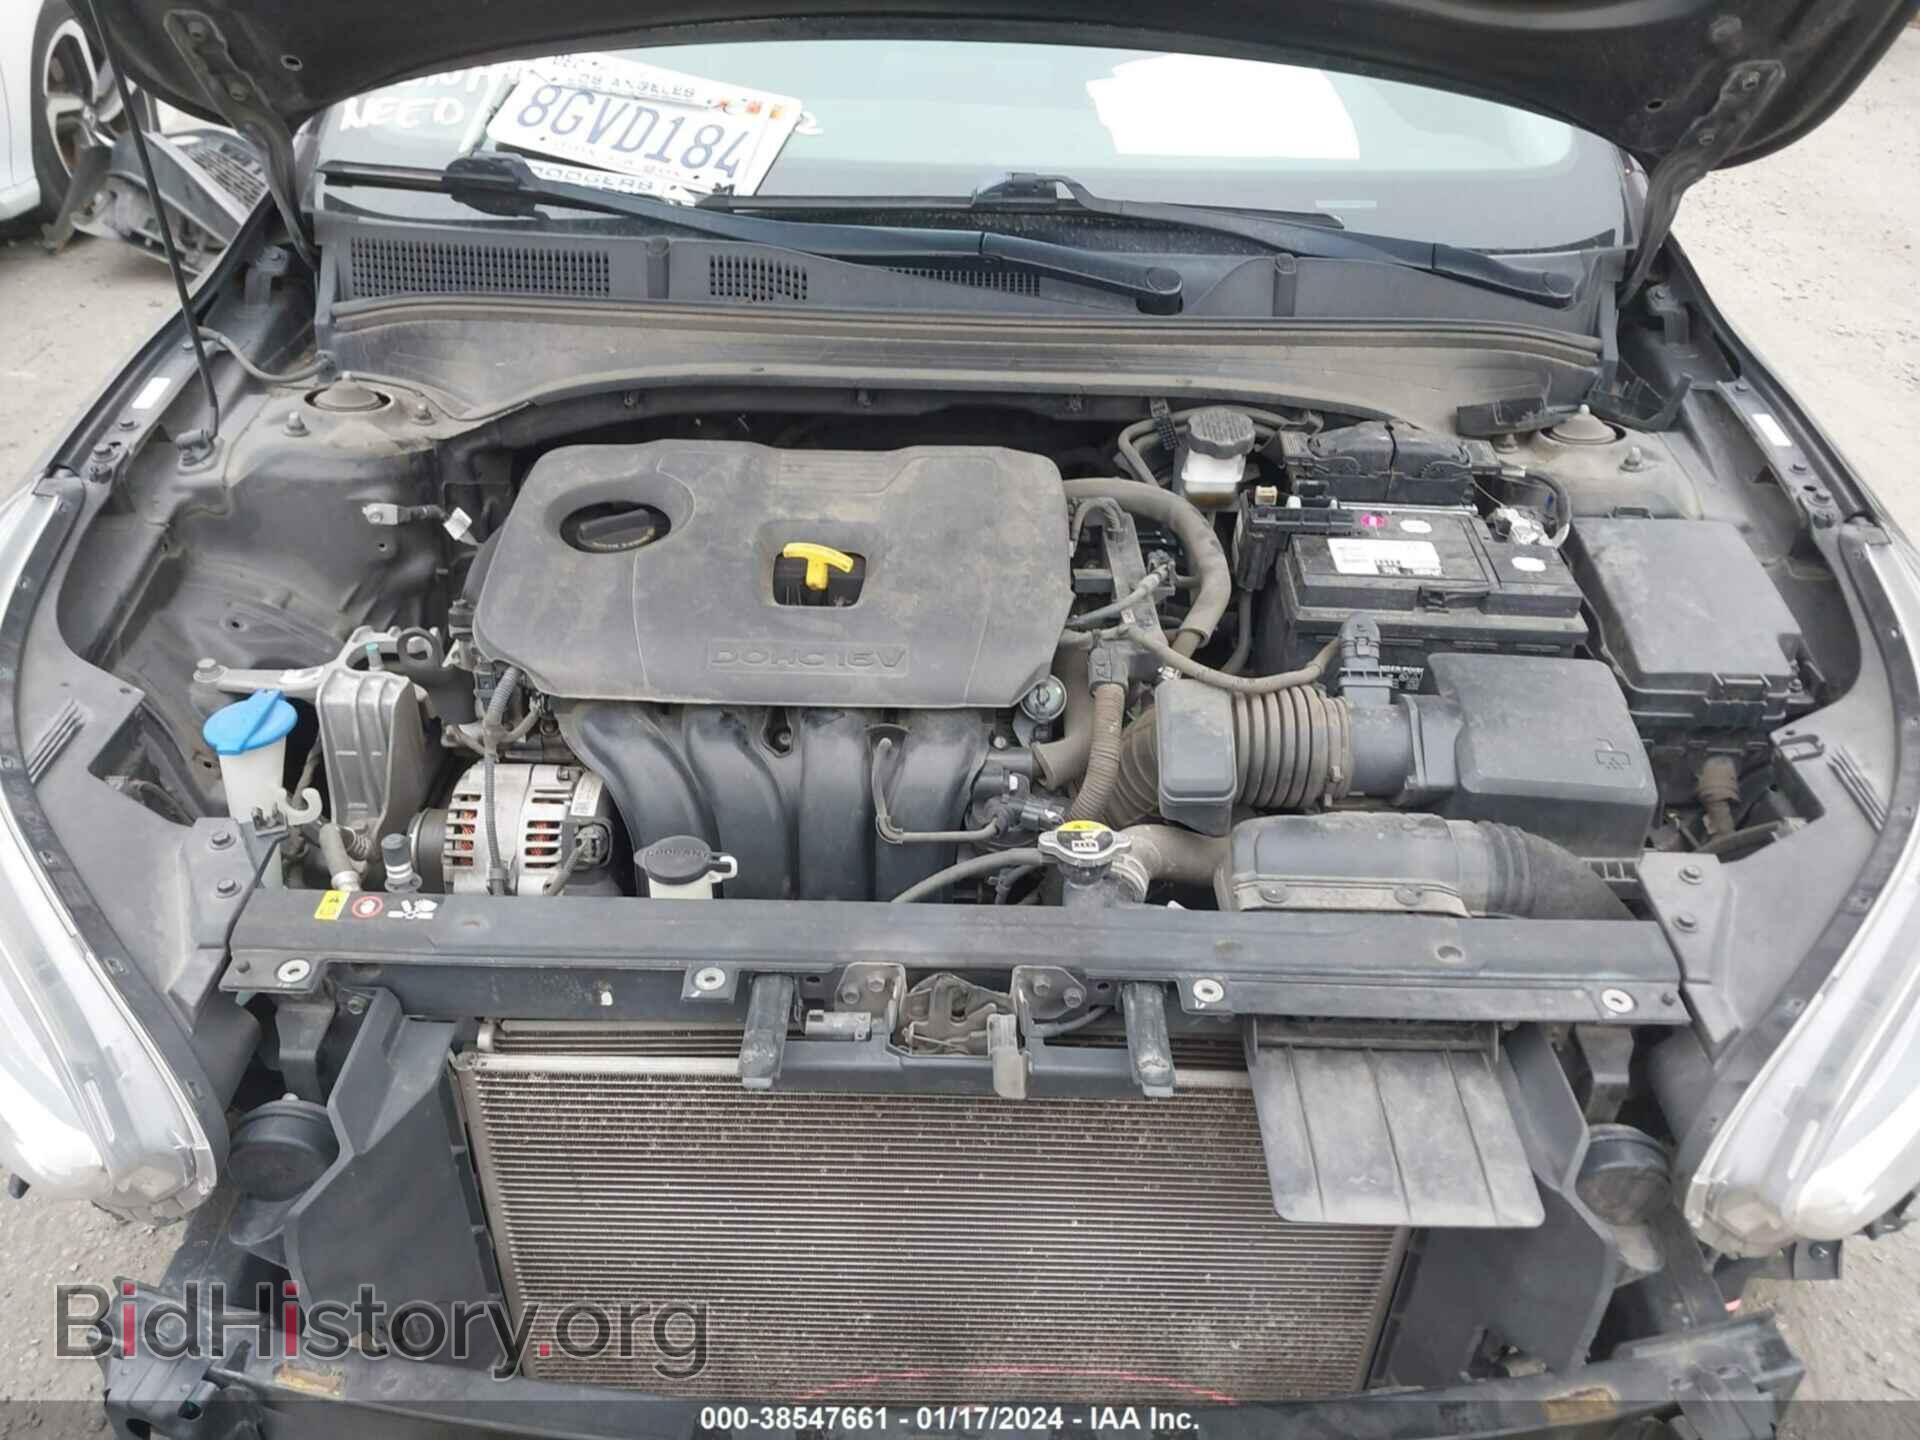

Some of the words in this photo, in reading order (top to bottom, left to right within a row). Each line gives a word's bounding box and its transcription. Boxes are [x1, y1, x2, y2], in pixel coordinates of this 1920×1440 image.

[611, 78, 697, 97] ANGELES
[340, 96, 465, 132] NEED
[517, 85, 750, 178] 8GVD184
[711, 648, 825, 669] DOHC
[835, 647, 906, 670] 16V
